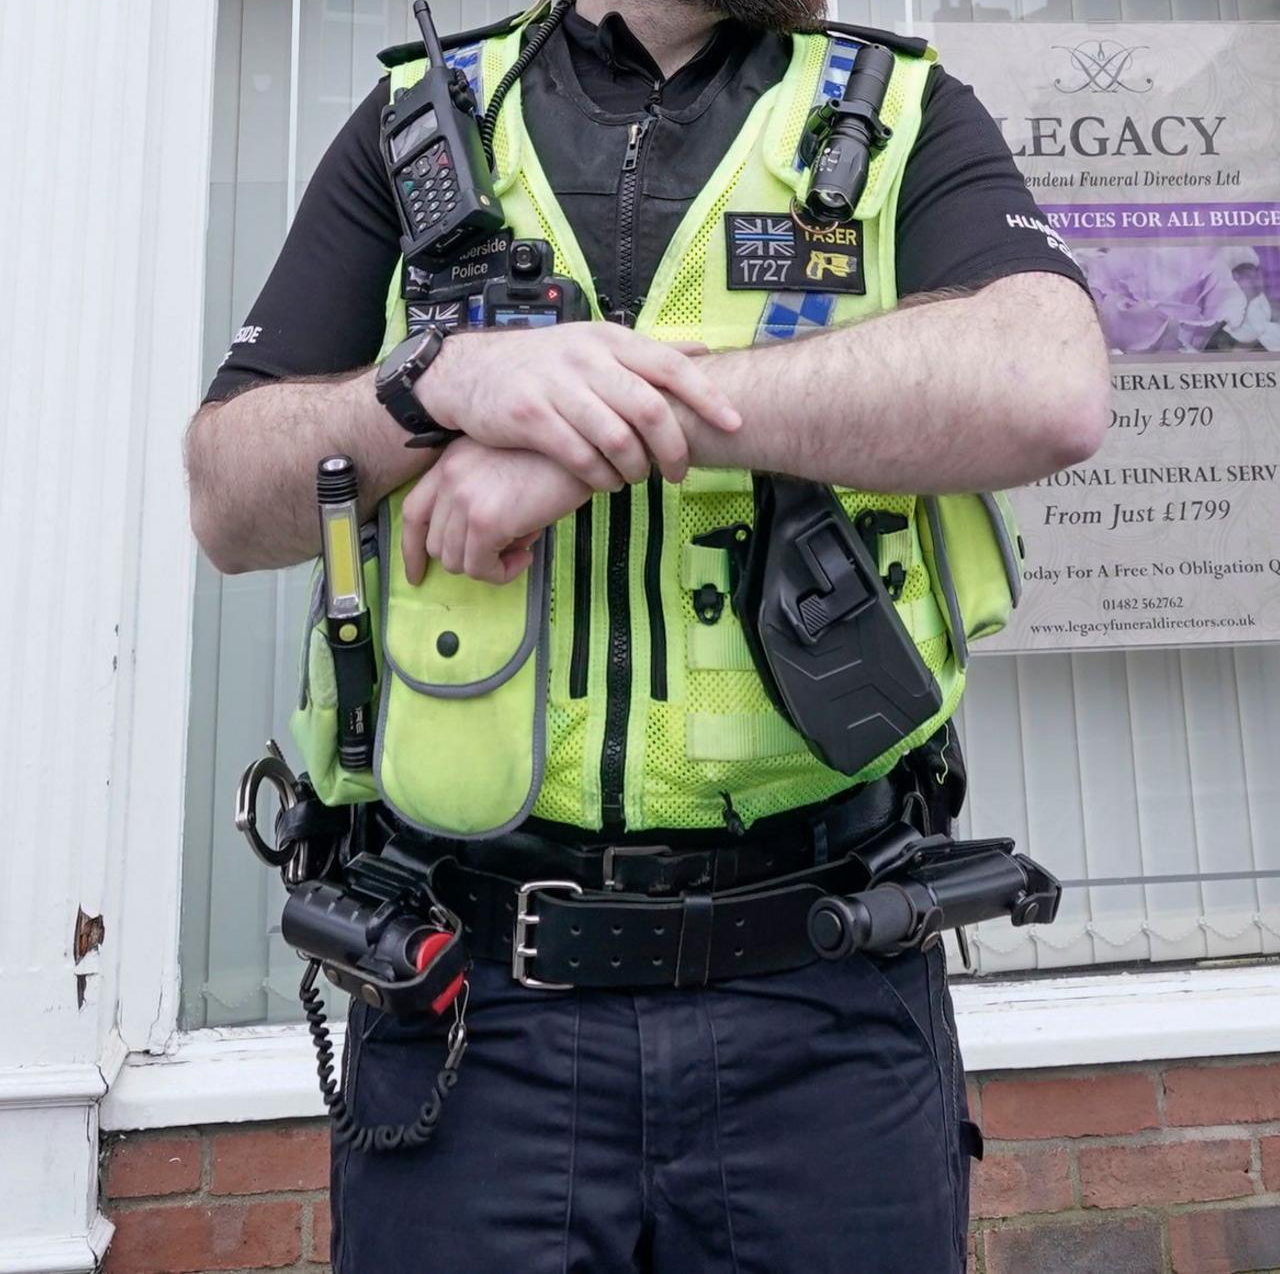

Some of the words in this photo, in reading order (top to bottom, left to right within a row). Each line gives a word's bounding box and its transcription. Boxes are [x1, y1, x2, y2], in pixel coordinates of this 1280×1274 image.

[1080, 171, 1139, 187] Funeral
[1143, 170, 1213, 187] Directors
[1215, 169, 1242, 186] Ltd
[1121, 211, 1162, 227] FOR
[1168, 211, 1206, 226] ALL
[804, 225, 857, 245] TASER
[451, 262, 489, 280] Police
[740, 259, 792, 282] 1727
[1179, 372, 1277, 390] SERVICES
[1158, 406, 1214, 427] £970
[1122, 466, 1222, 485] FUNERAL
[1043, 505, 1102, 526] From
[1108, 503, 1156, 530] Just
[1162, 500, 1231, 522] £1799
[1066, 565, 1093, 579] For
[1097, 564, 1109, 578] A
[1114, 564, 1148, 577] Free
[1152, 563, 1175, 576] No
[1179, 559, 1264, 580] Obligation
[1102, 598, 1138, 611] 01482
[1142, 596, 1184, 610] 562762
[1030, 614, 1256, 636] www.legacyfuneraldirectors.co.uk
